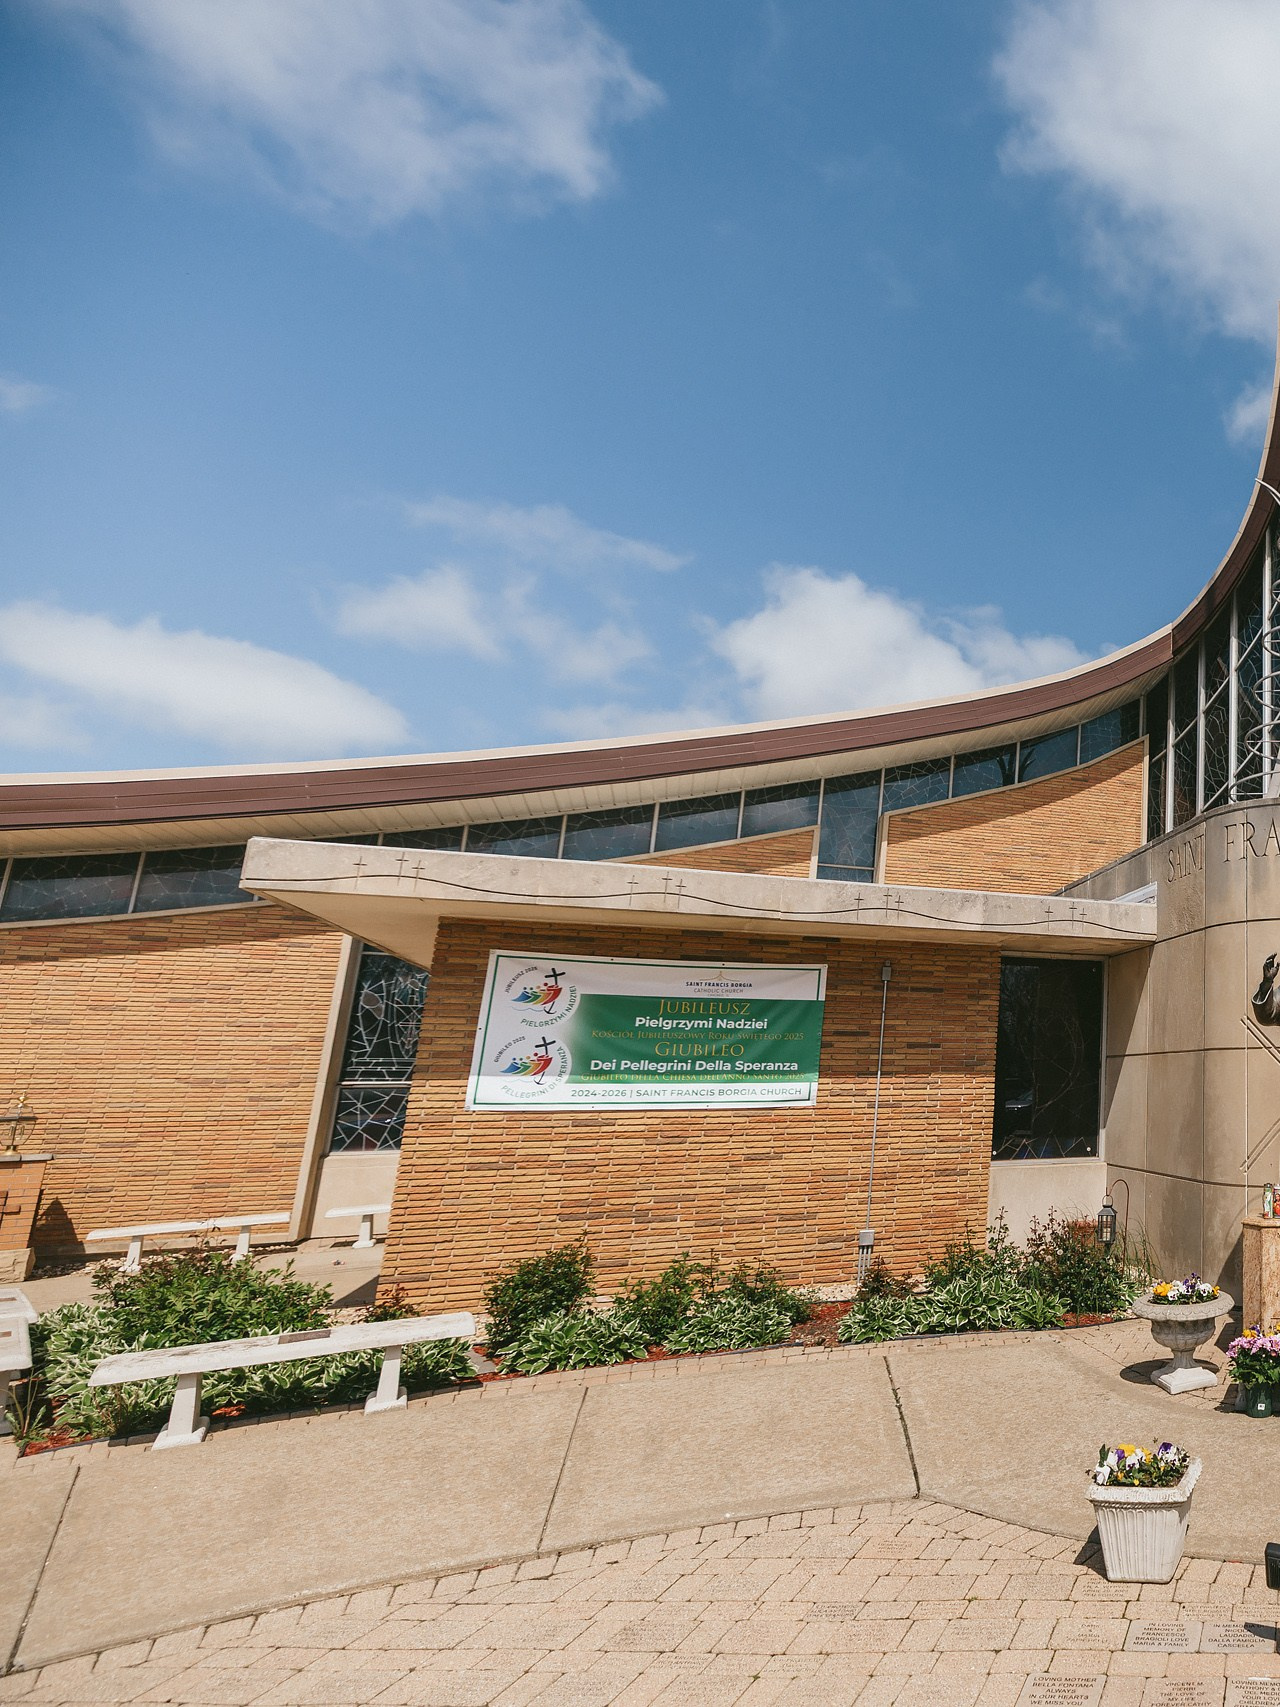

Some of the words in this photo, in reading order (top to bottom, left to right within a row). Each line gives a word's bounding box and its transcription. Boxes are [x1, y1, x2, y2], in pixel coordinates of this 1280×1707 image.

[1167, 833, 1204, 883] SAINT
[504, 970, 525, 993] JUBILEUSZ
[520, 1011, 567, 1027] PIELGRZYMI
[565, 985, 578, 1013] NADZIEI
[658, 999, 751, 1017] JUBILEUSZ
[634, 1016, 713, 1030] Pielgrzymi
[716, 1018, 768, 1029] Nadziei
[637, 1031, 706, 1040] JUBILEUSZOWY
[708, 1032, 735, 1040] ROKU
[494, 1041, 513, 1062] GIUBILEO
[655, 1041, 745, 1057] GIUBILEO
[501, 1085, 549, 1099] PELLEGRINI
[549, 1081, 557, 1090] DI
[555, 1046, 568, 1083] SPERANZA
[590, 1059, 617, 1070] Dei
[620, 1059, 692, 1073] Pellegrini
[695, 1060, 731, 1071] Della
[734, 1060, 799, 1073] Speranza
[581, 1073, 628, 1081] GIUBILEO
[631, 1073, 659, 1081] DELLA
[662, 1073, 697, 1081] CHIESA
[571, 1089, 627, 1097] 2024-2026
[635, 1089, 668, 1097] SAINT
[670, 1089, 715, 1097] FRANCIS
[718, 1088, 757, 1096] BORGIA
[760, 1088, 802, 1096] CHURCH
